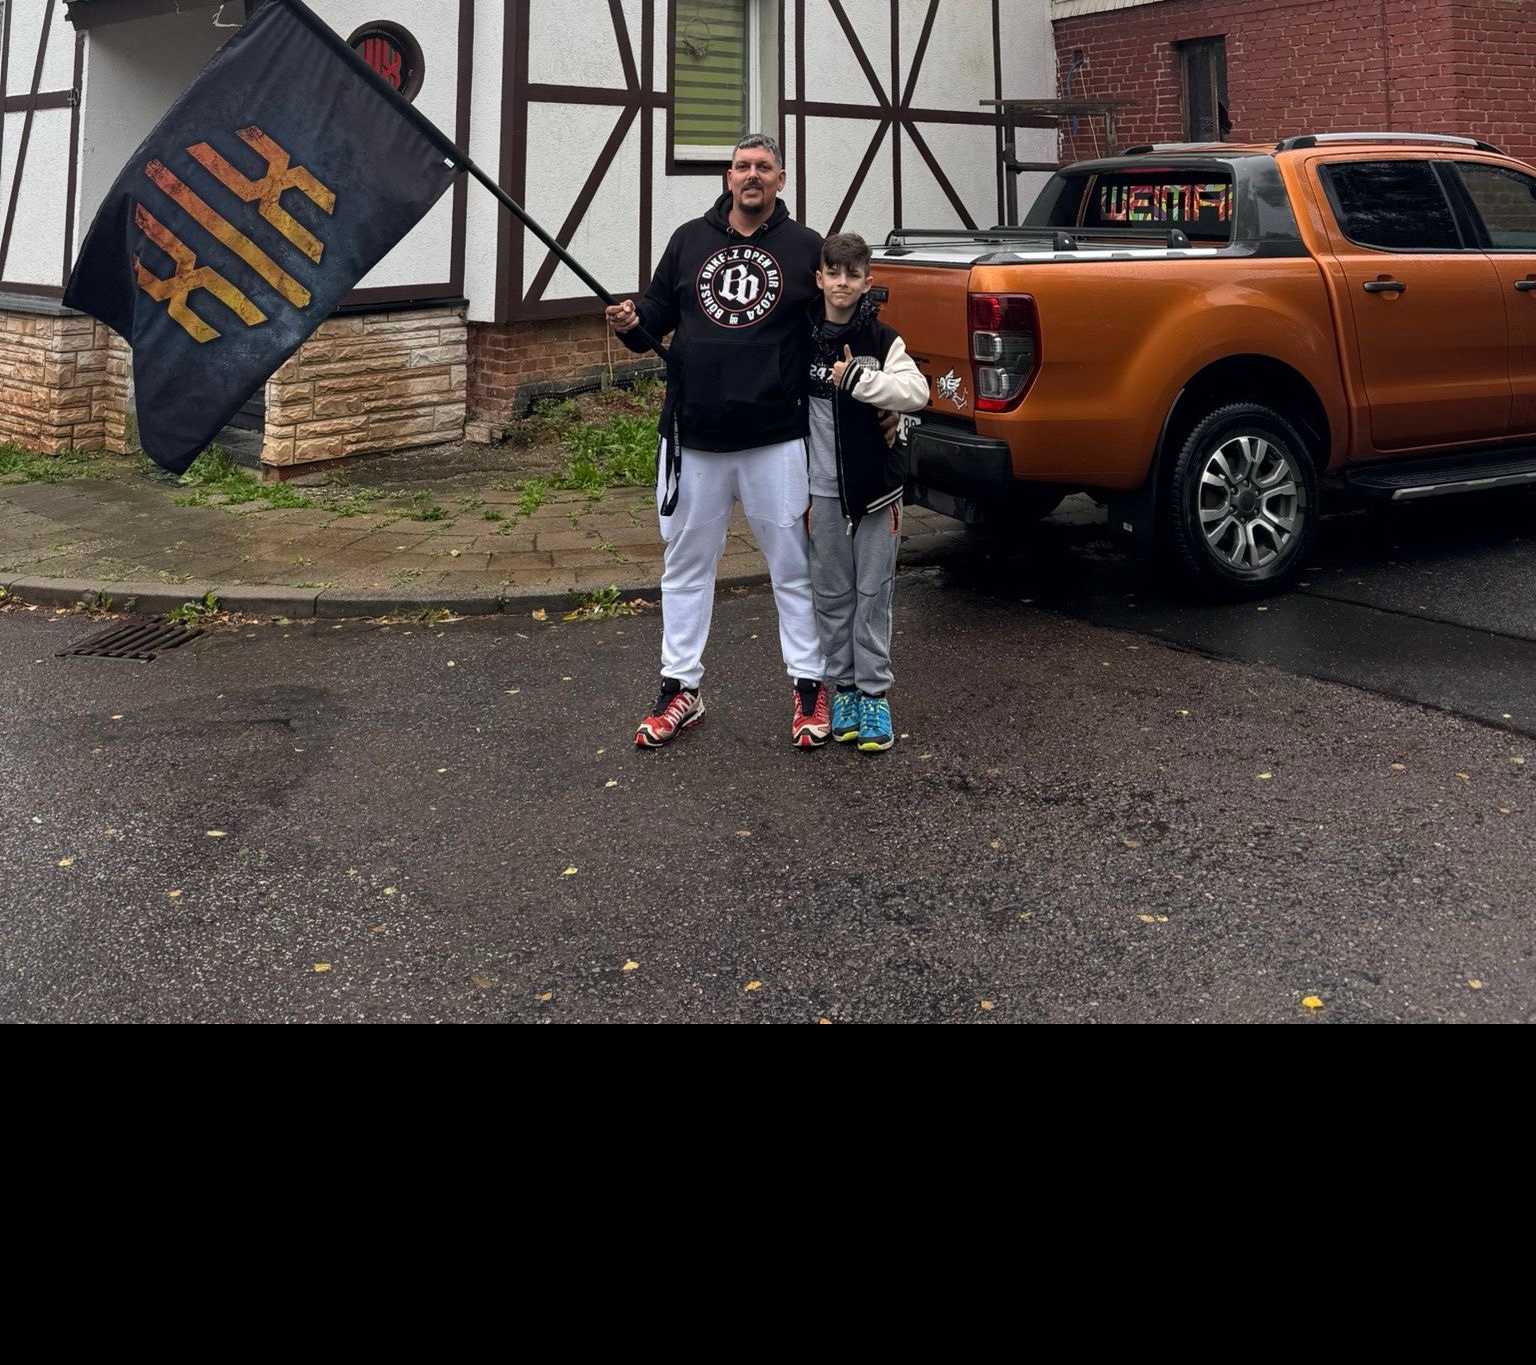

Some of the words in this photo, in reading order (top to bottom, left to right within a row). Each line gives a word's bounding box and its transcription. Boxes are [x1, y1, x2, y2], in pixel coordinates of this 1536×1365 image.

[743, 249, 773, 269] OPEN
[766, 269, 779, 288] AIR
[746, 291, 776, 321] 2024
